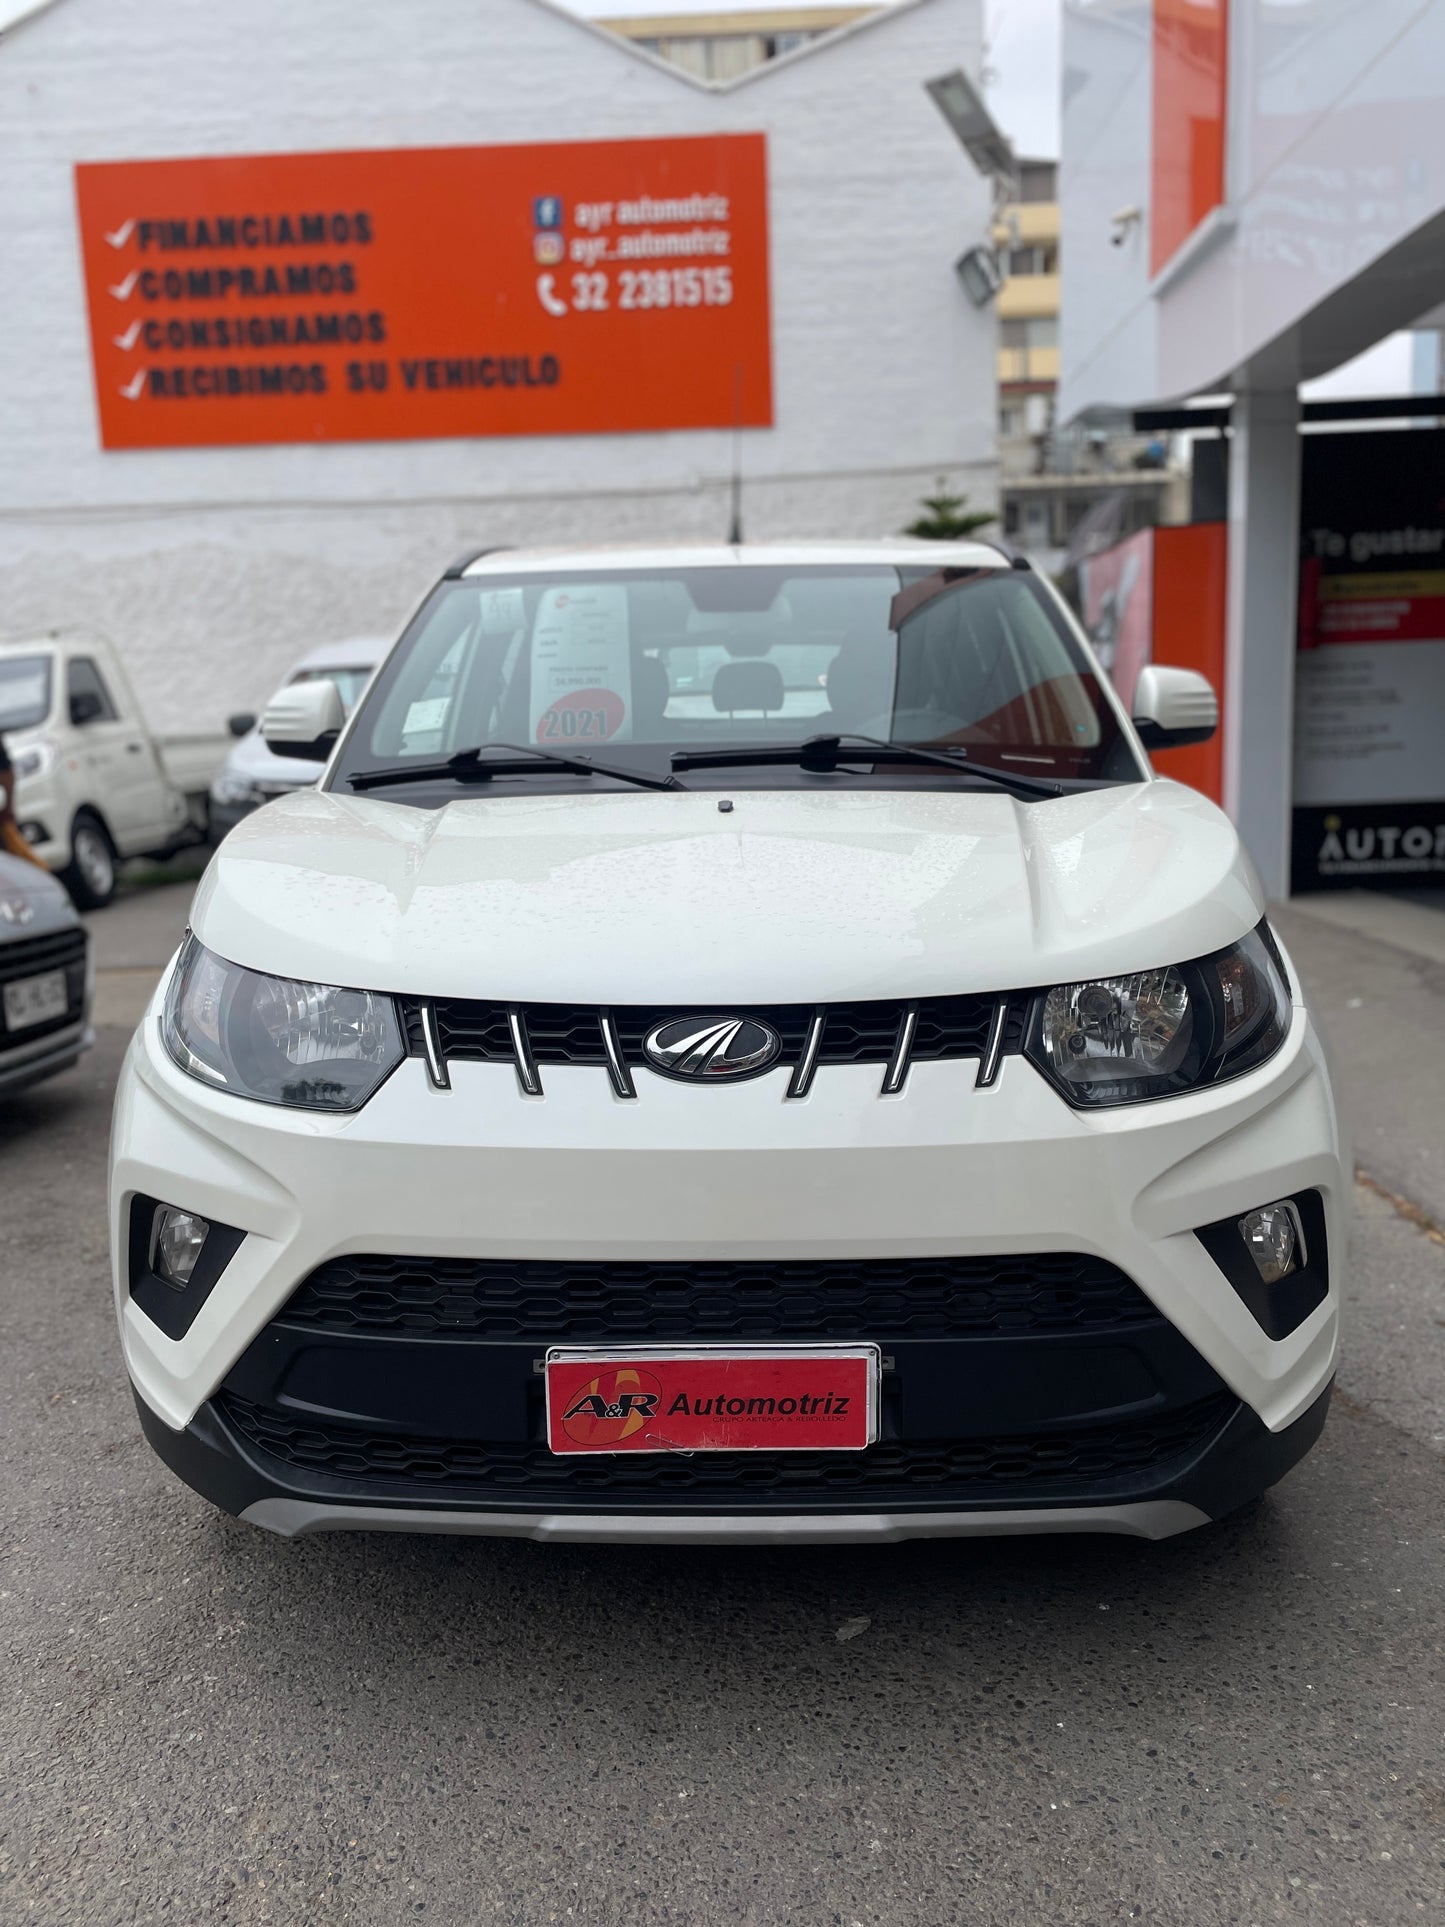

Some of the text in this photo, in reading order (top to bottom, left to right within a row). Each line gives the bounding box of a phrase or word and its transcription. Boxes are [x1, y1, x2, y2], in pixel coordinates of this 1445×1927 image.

[136, 211, 373, 250] FINANCIAMOS
[574, 195, 729, 232] ayr automotriz
[138, 263, 357, 301] COMPRAMOS
[571, 265, 733, 311] 32 2381515
[143, 311, 386, 350] CONSIGNAMOS
[148, 354, 560, 398] RECIBIMOS SU VEHICULO
[544, 709, 609, 738] 2021
[561, 1392, 850, 1419] A&R Automotriz
